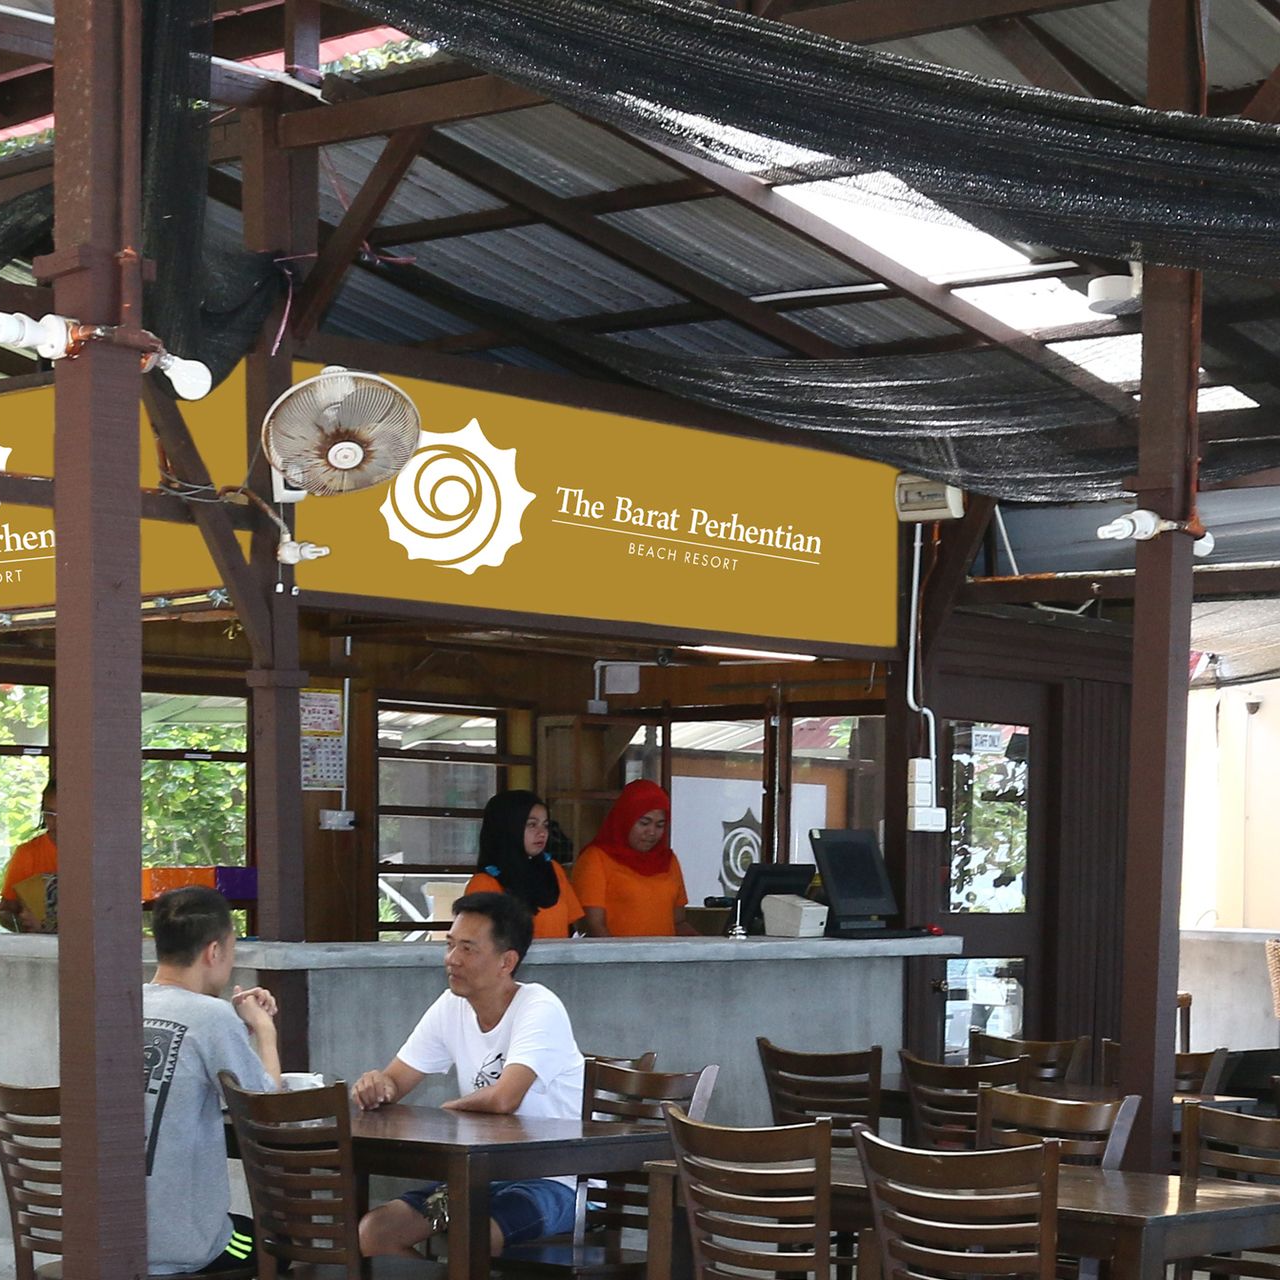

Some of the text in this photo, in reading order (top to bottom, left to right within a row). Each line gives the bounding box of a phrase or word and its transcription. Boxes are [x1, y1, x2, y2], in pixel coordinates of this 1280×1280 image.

[556, 486, 822, 556] The Barat Perhentian
[628, 542, 740, 571] BEACH RESORT
